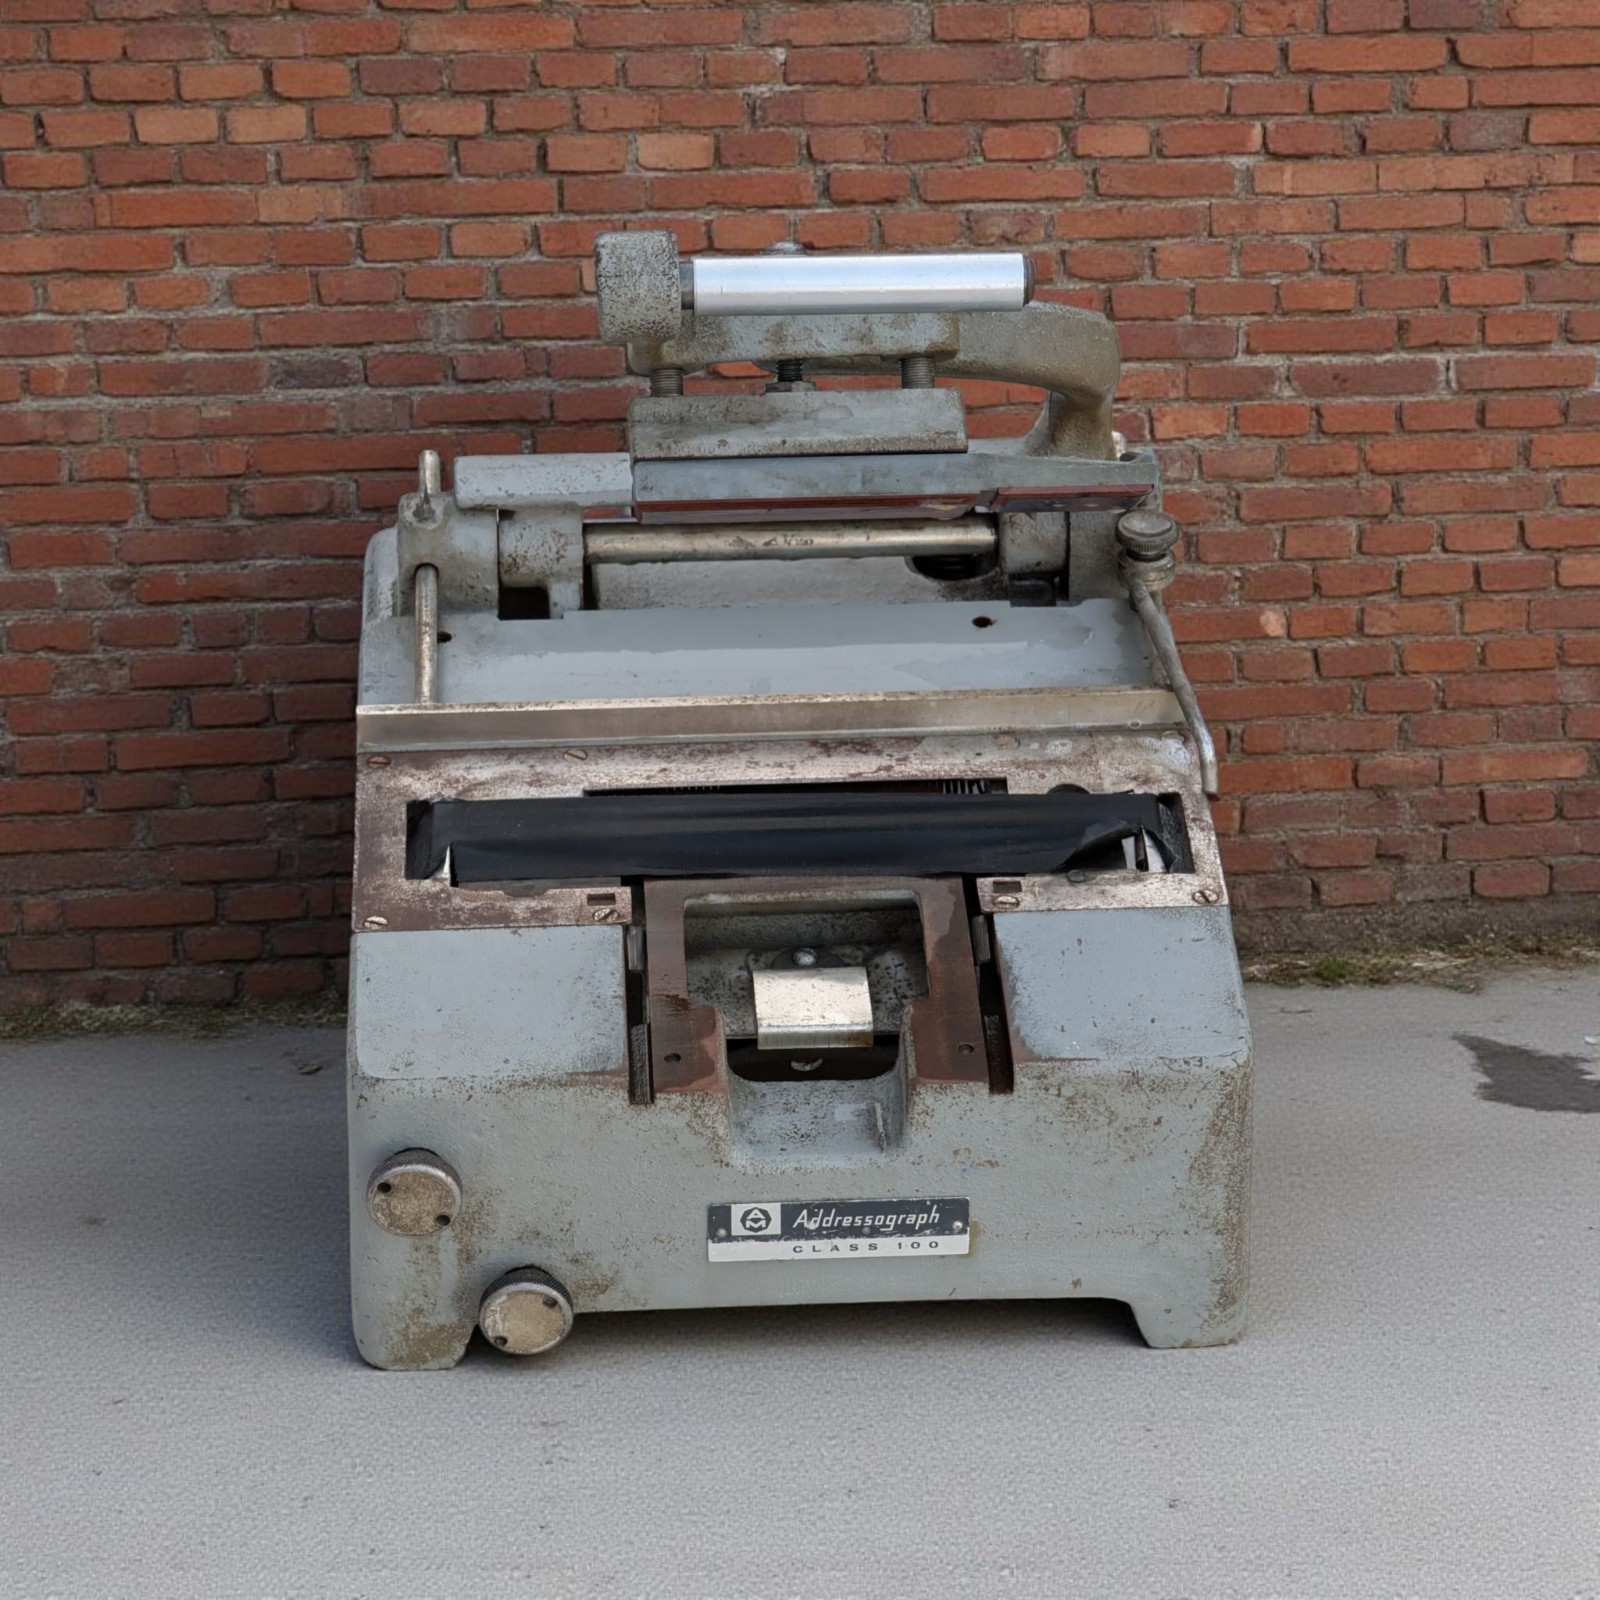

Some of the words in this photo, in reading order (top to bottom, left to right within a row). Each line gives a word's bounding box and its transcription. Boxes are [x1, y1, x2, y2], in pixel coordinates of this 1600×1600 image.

[792, 1204, 940, 1231] Addressograph
[793, 1242, 879, 1254] CLASS
[896, 1240, 940, 1250] 100
